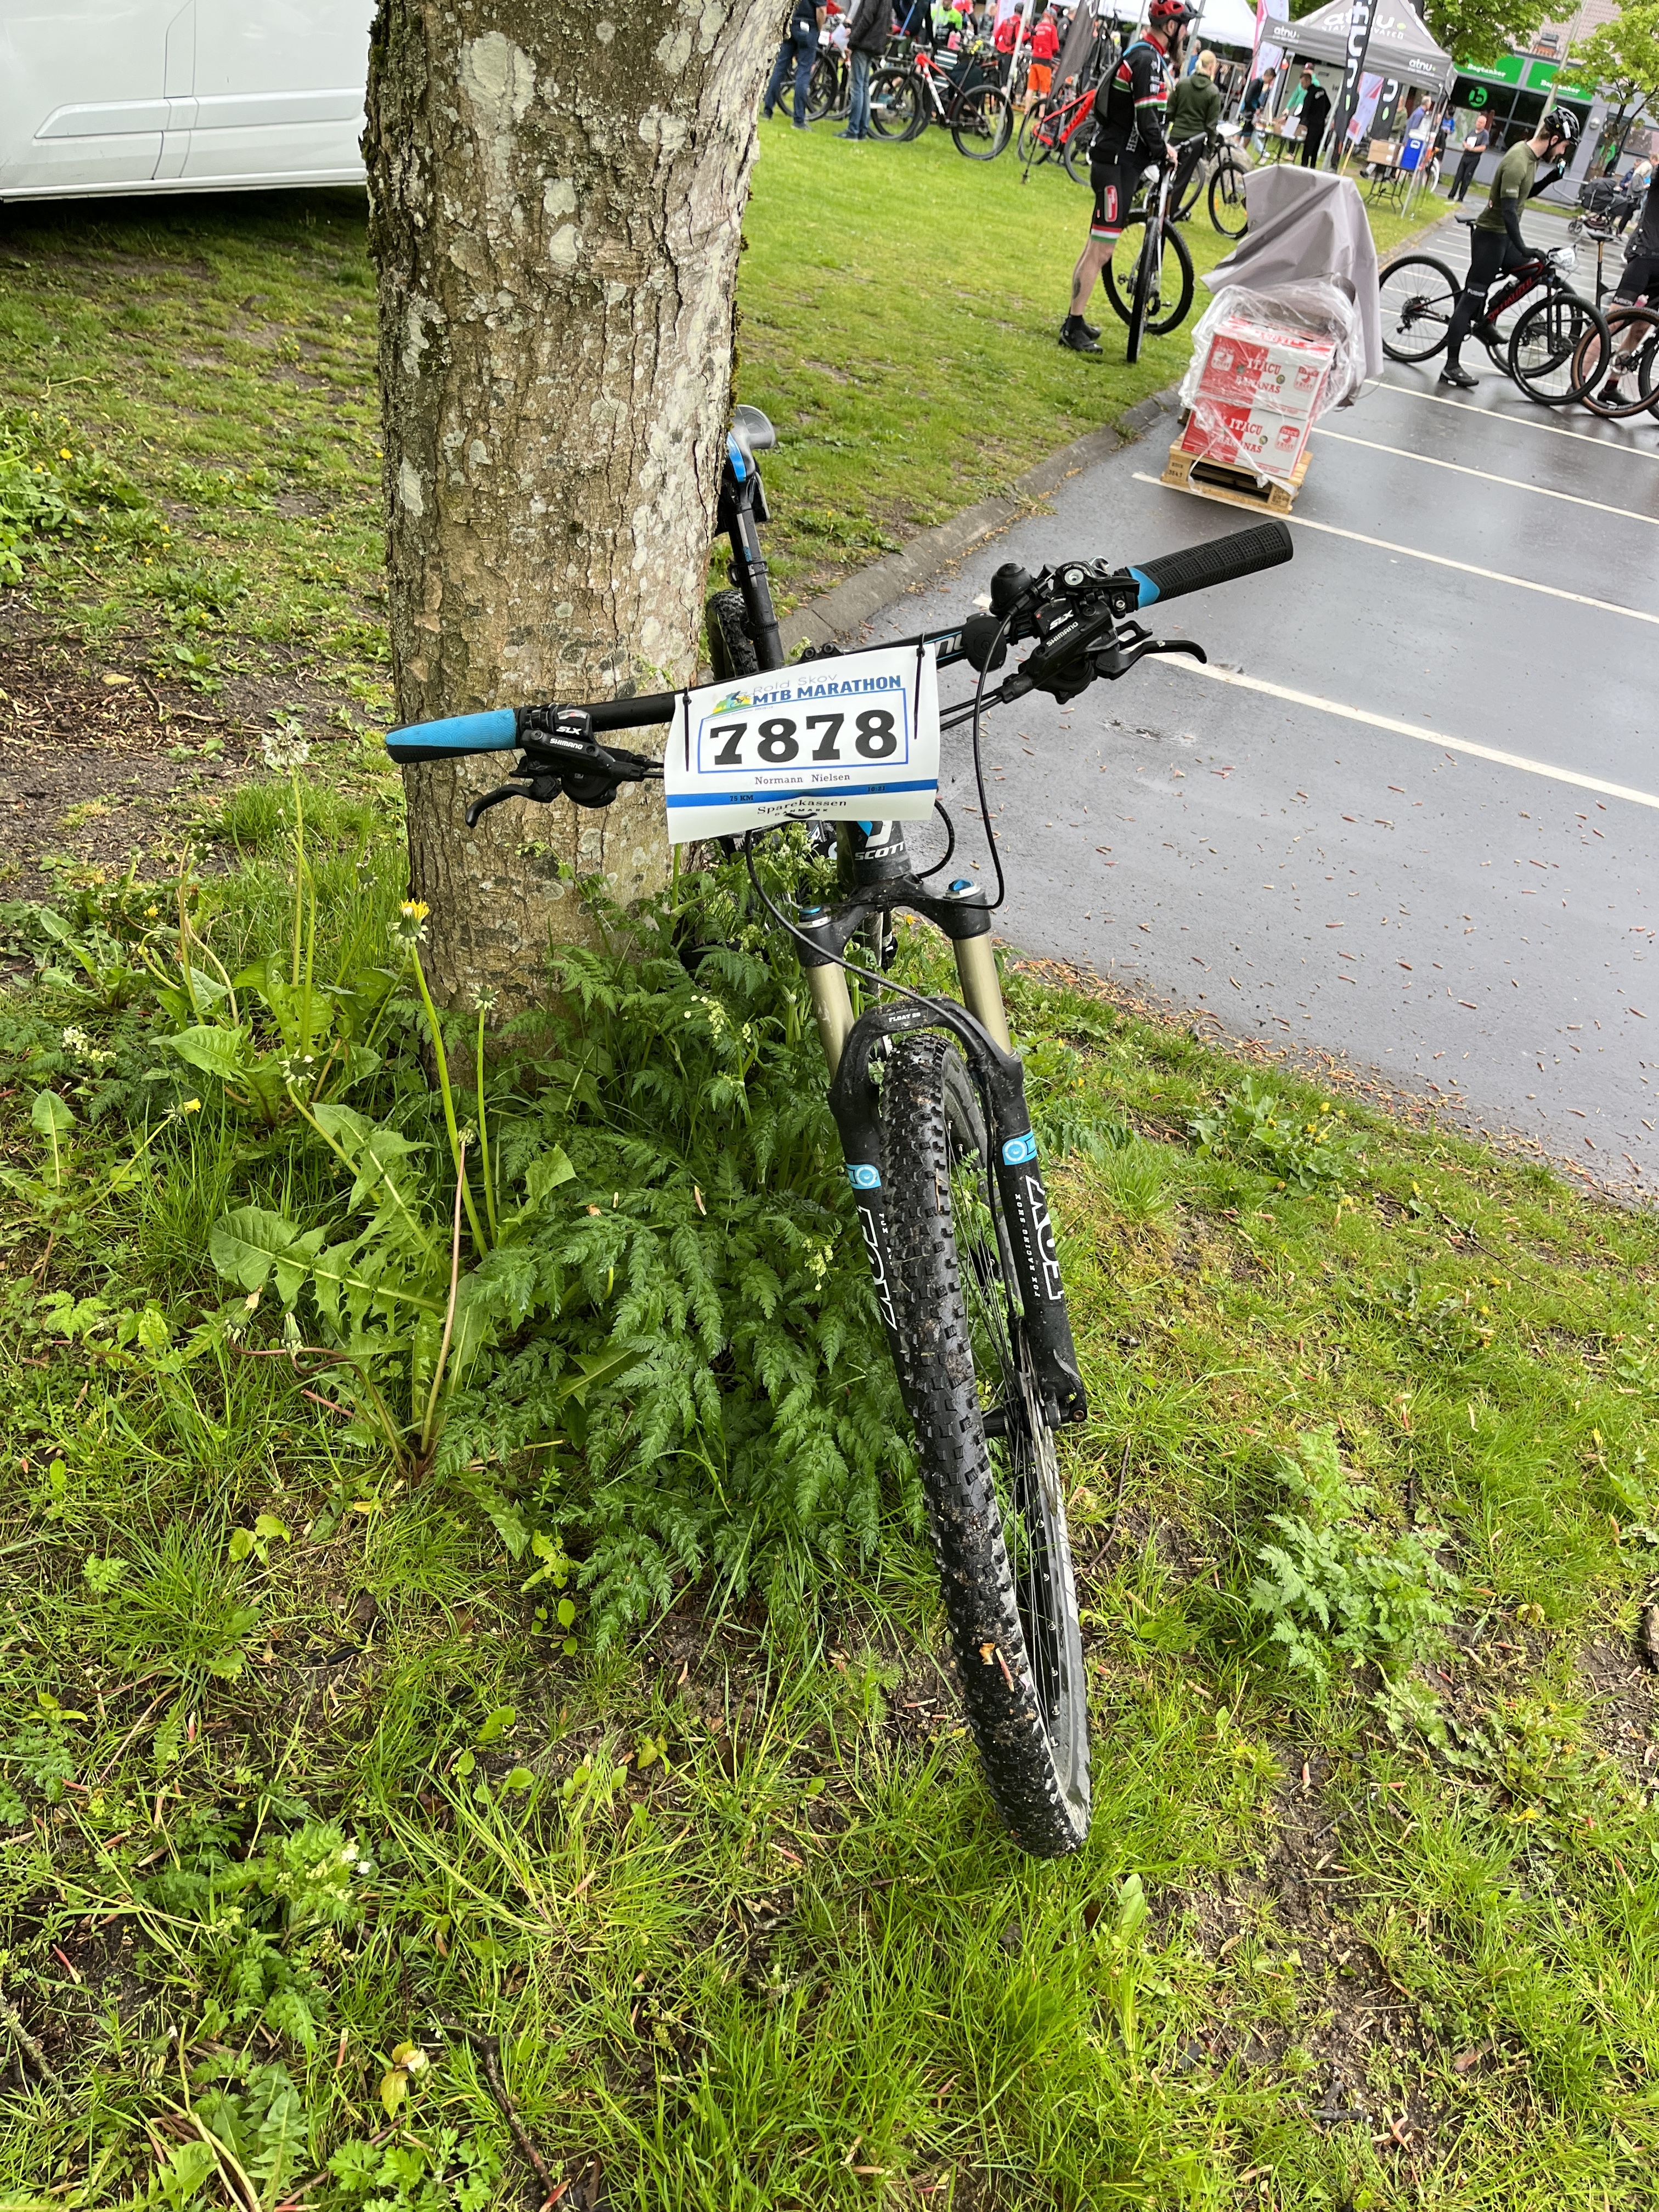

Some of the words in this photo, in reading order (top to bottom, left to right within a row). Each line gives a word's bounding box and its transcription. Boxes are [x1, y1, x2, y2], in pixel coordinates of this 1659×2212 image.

[1246, 357, 1282, 375] ITACU
[1229, 418, 1263, 435] ITACU
[1049, 610, 1075, 631] SLX
[1046, 622, 1079, 647] SHIMANO
[753, 690, 791, 706] MTB
[797, 675, 901, 699] MARATHON
[754, 680, 790, 692] Rold
[798, 674, 838, 686] Skov
[556, 725, 582, 735] SLX
[709, 709, 898, 765] 7878
[549, 737, 583, 750] SHIMANO
[755, 776, 803, 785] Normann
[811, 774, 850, 782] Nielsen
[757, 799, 847, 815] Sparekassen
[854, 842, 905, 861] SCOTT
[889, 1013, 911, 1022] FLOAT
[1014, 1193, 1026, 1223] SHOX
[1022, 1228, 1035, 1271] RACING
[1031, 1276, 1041, 1297] FOX
